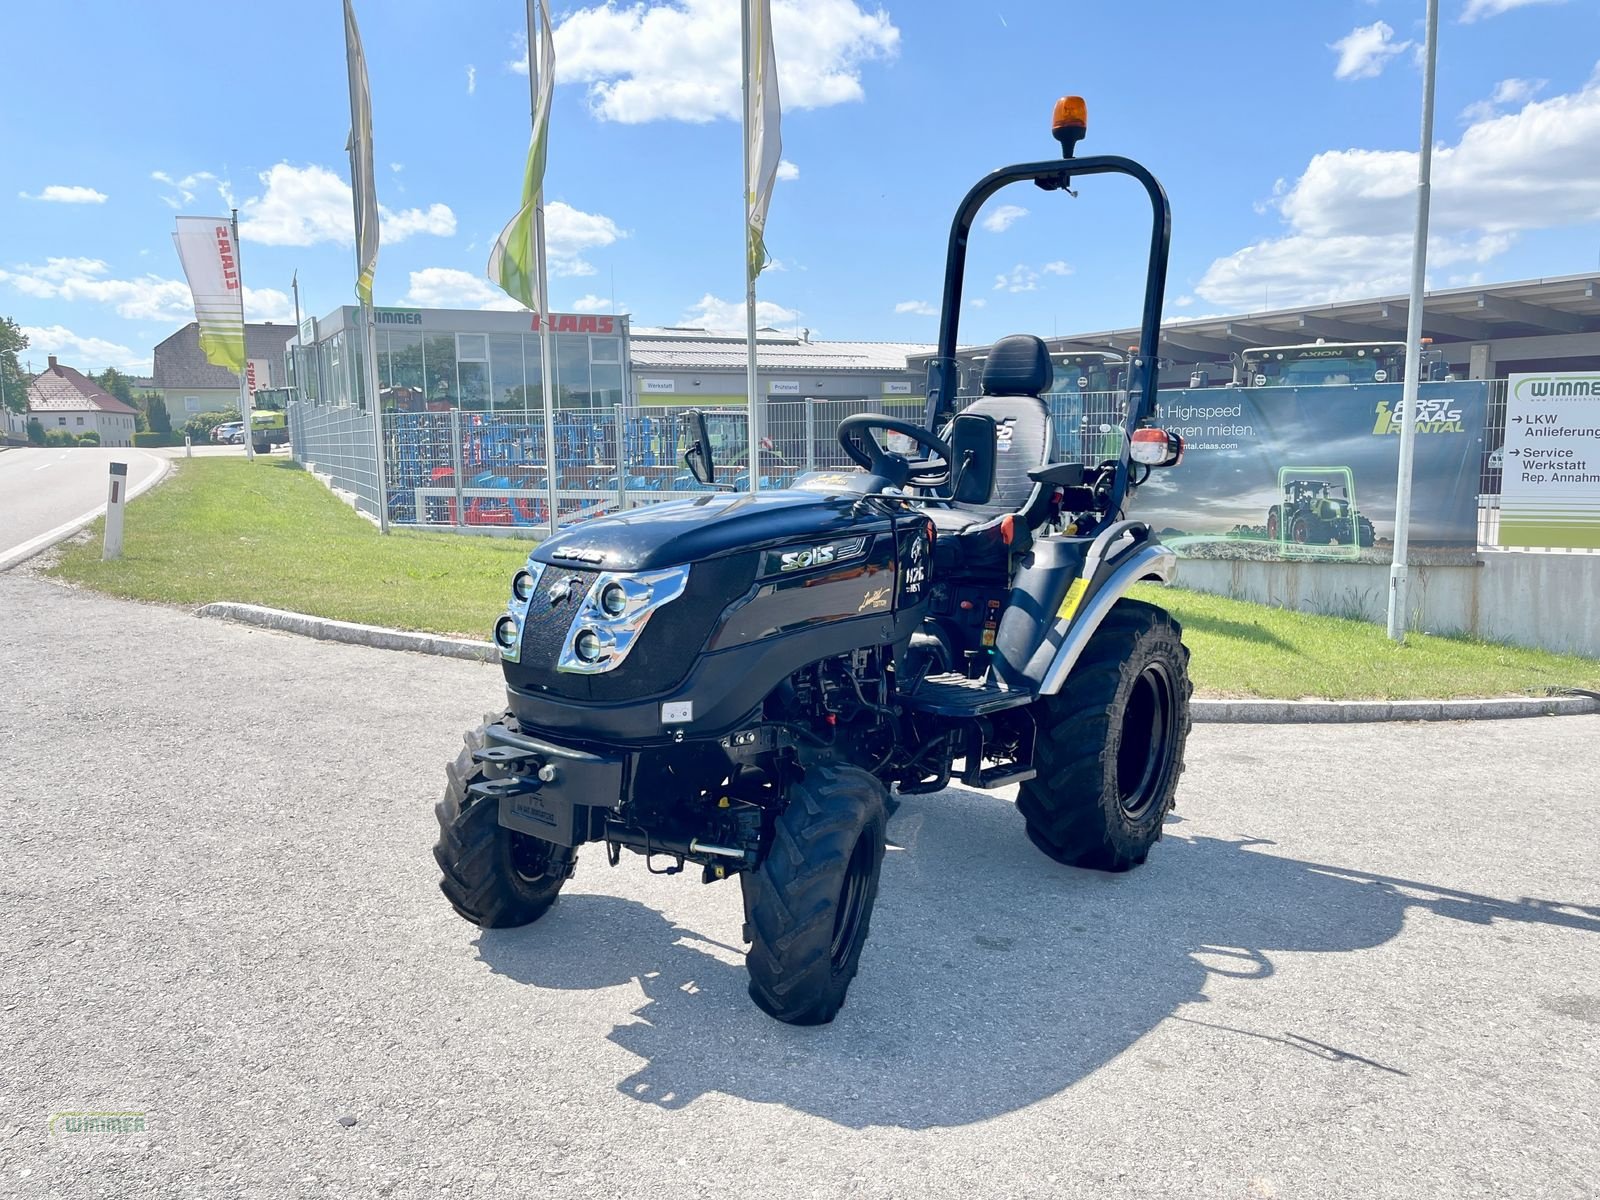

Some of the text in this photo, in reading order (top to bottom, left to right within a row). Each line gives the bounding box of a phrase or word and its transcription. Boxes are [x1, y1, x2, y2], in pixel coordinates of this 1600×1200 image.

[370, 311, 422, 325] IMMER
[1298, 350, 1343, 358] AXION
[1167, 403, 1242, 420] Highspeed
[1394, 399, 1455, 412] FRST
[1391, 410, 1463, 423] CAAS
[1526, 415, 1558, 425] LKW
[1207, 424, 1256, 437] mieten.
[1387, 421, 1465, 435] RNTAL
[1523, 448, 1574, 458] Service
[1523, 460, 1587, 470] Werkstatt
[1521, 472, 1547, 484] Rep.
